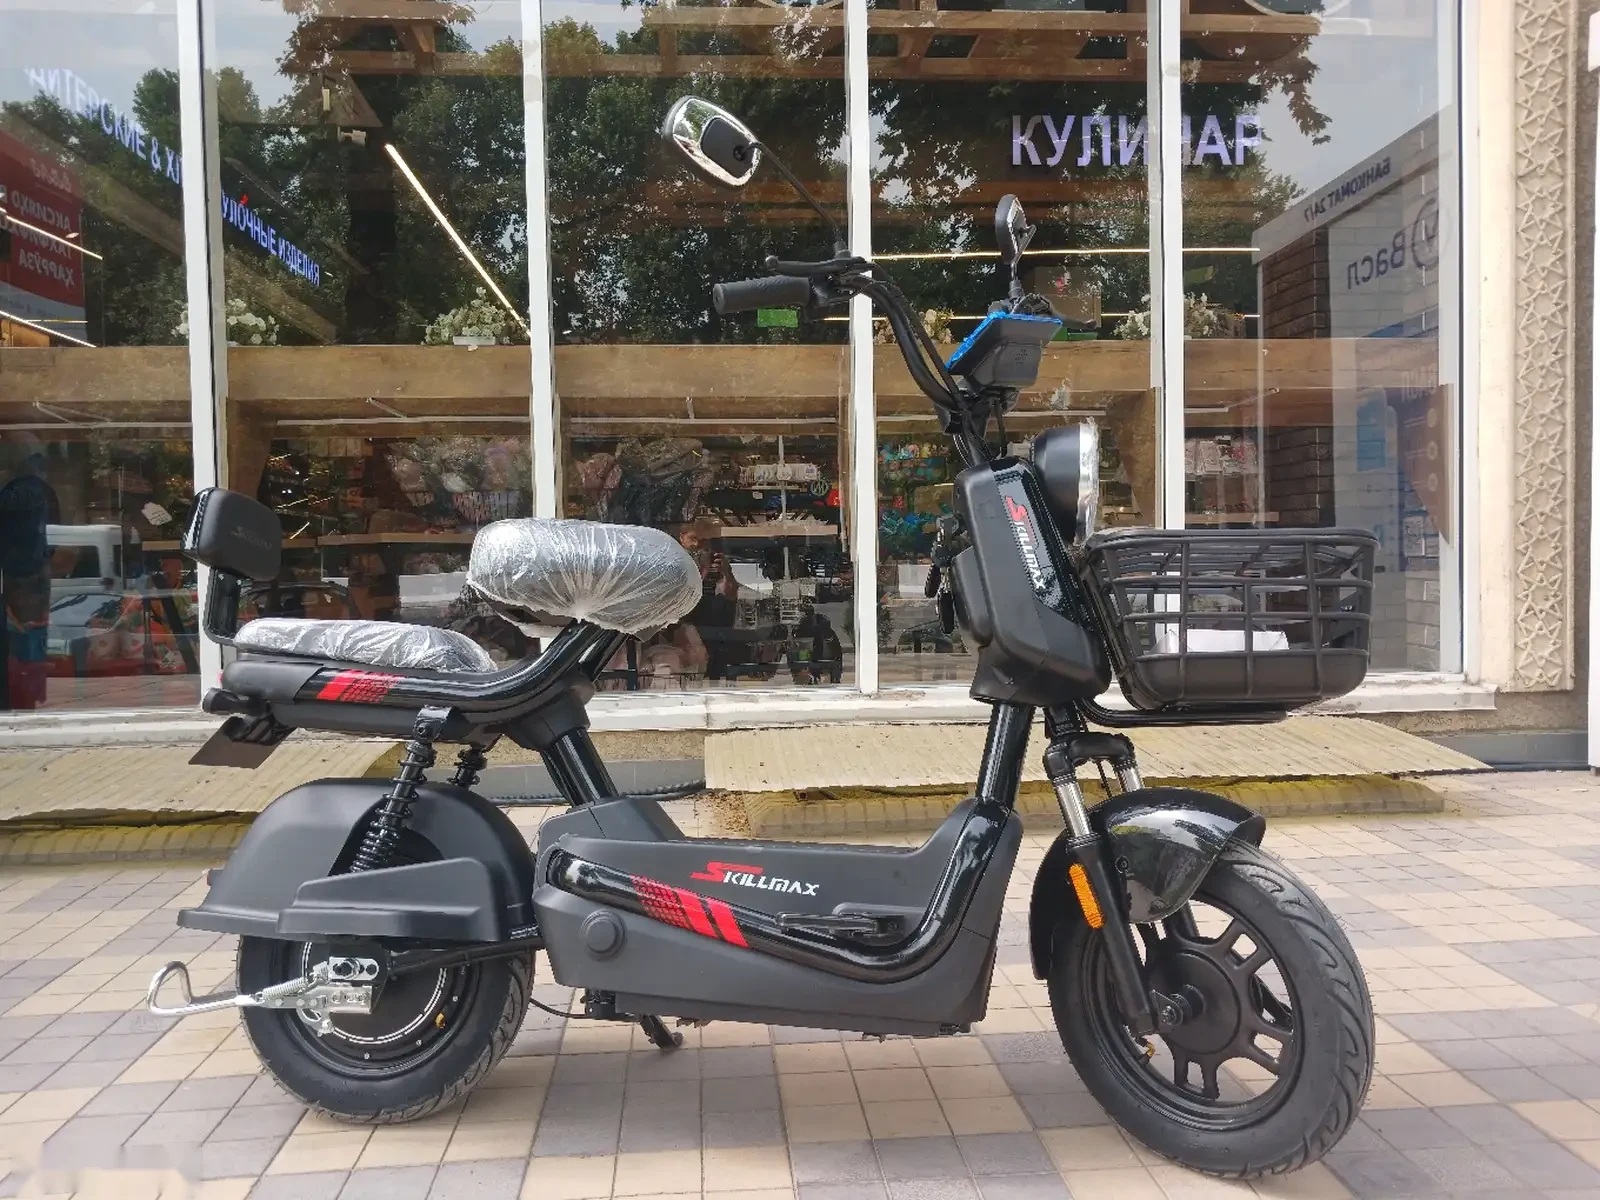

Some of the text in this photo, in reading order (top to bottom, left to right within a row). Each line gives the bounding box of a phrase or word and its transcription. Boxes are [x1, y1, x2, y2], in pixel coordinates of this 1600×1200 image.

[278, 237, 320, 288] ИЗДЕЛИЯ
[1004, 495, 1046, 589] SKILLMAX
[690, 861, 821, 897] SKILLMAX
